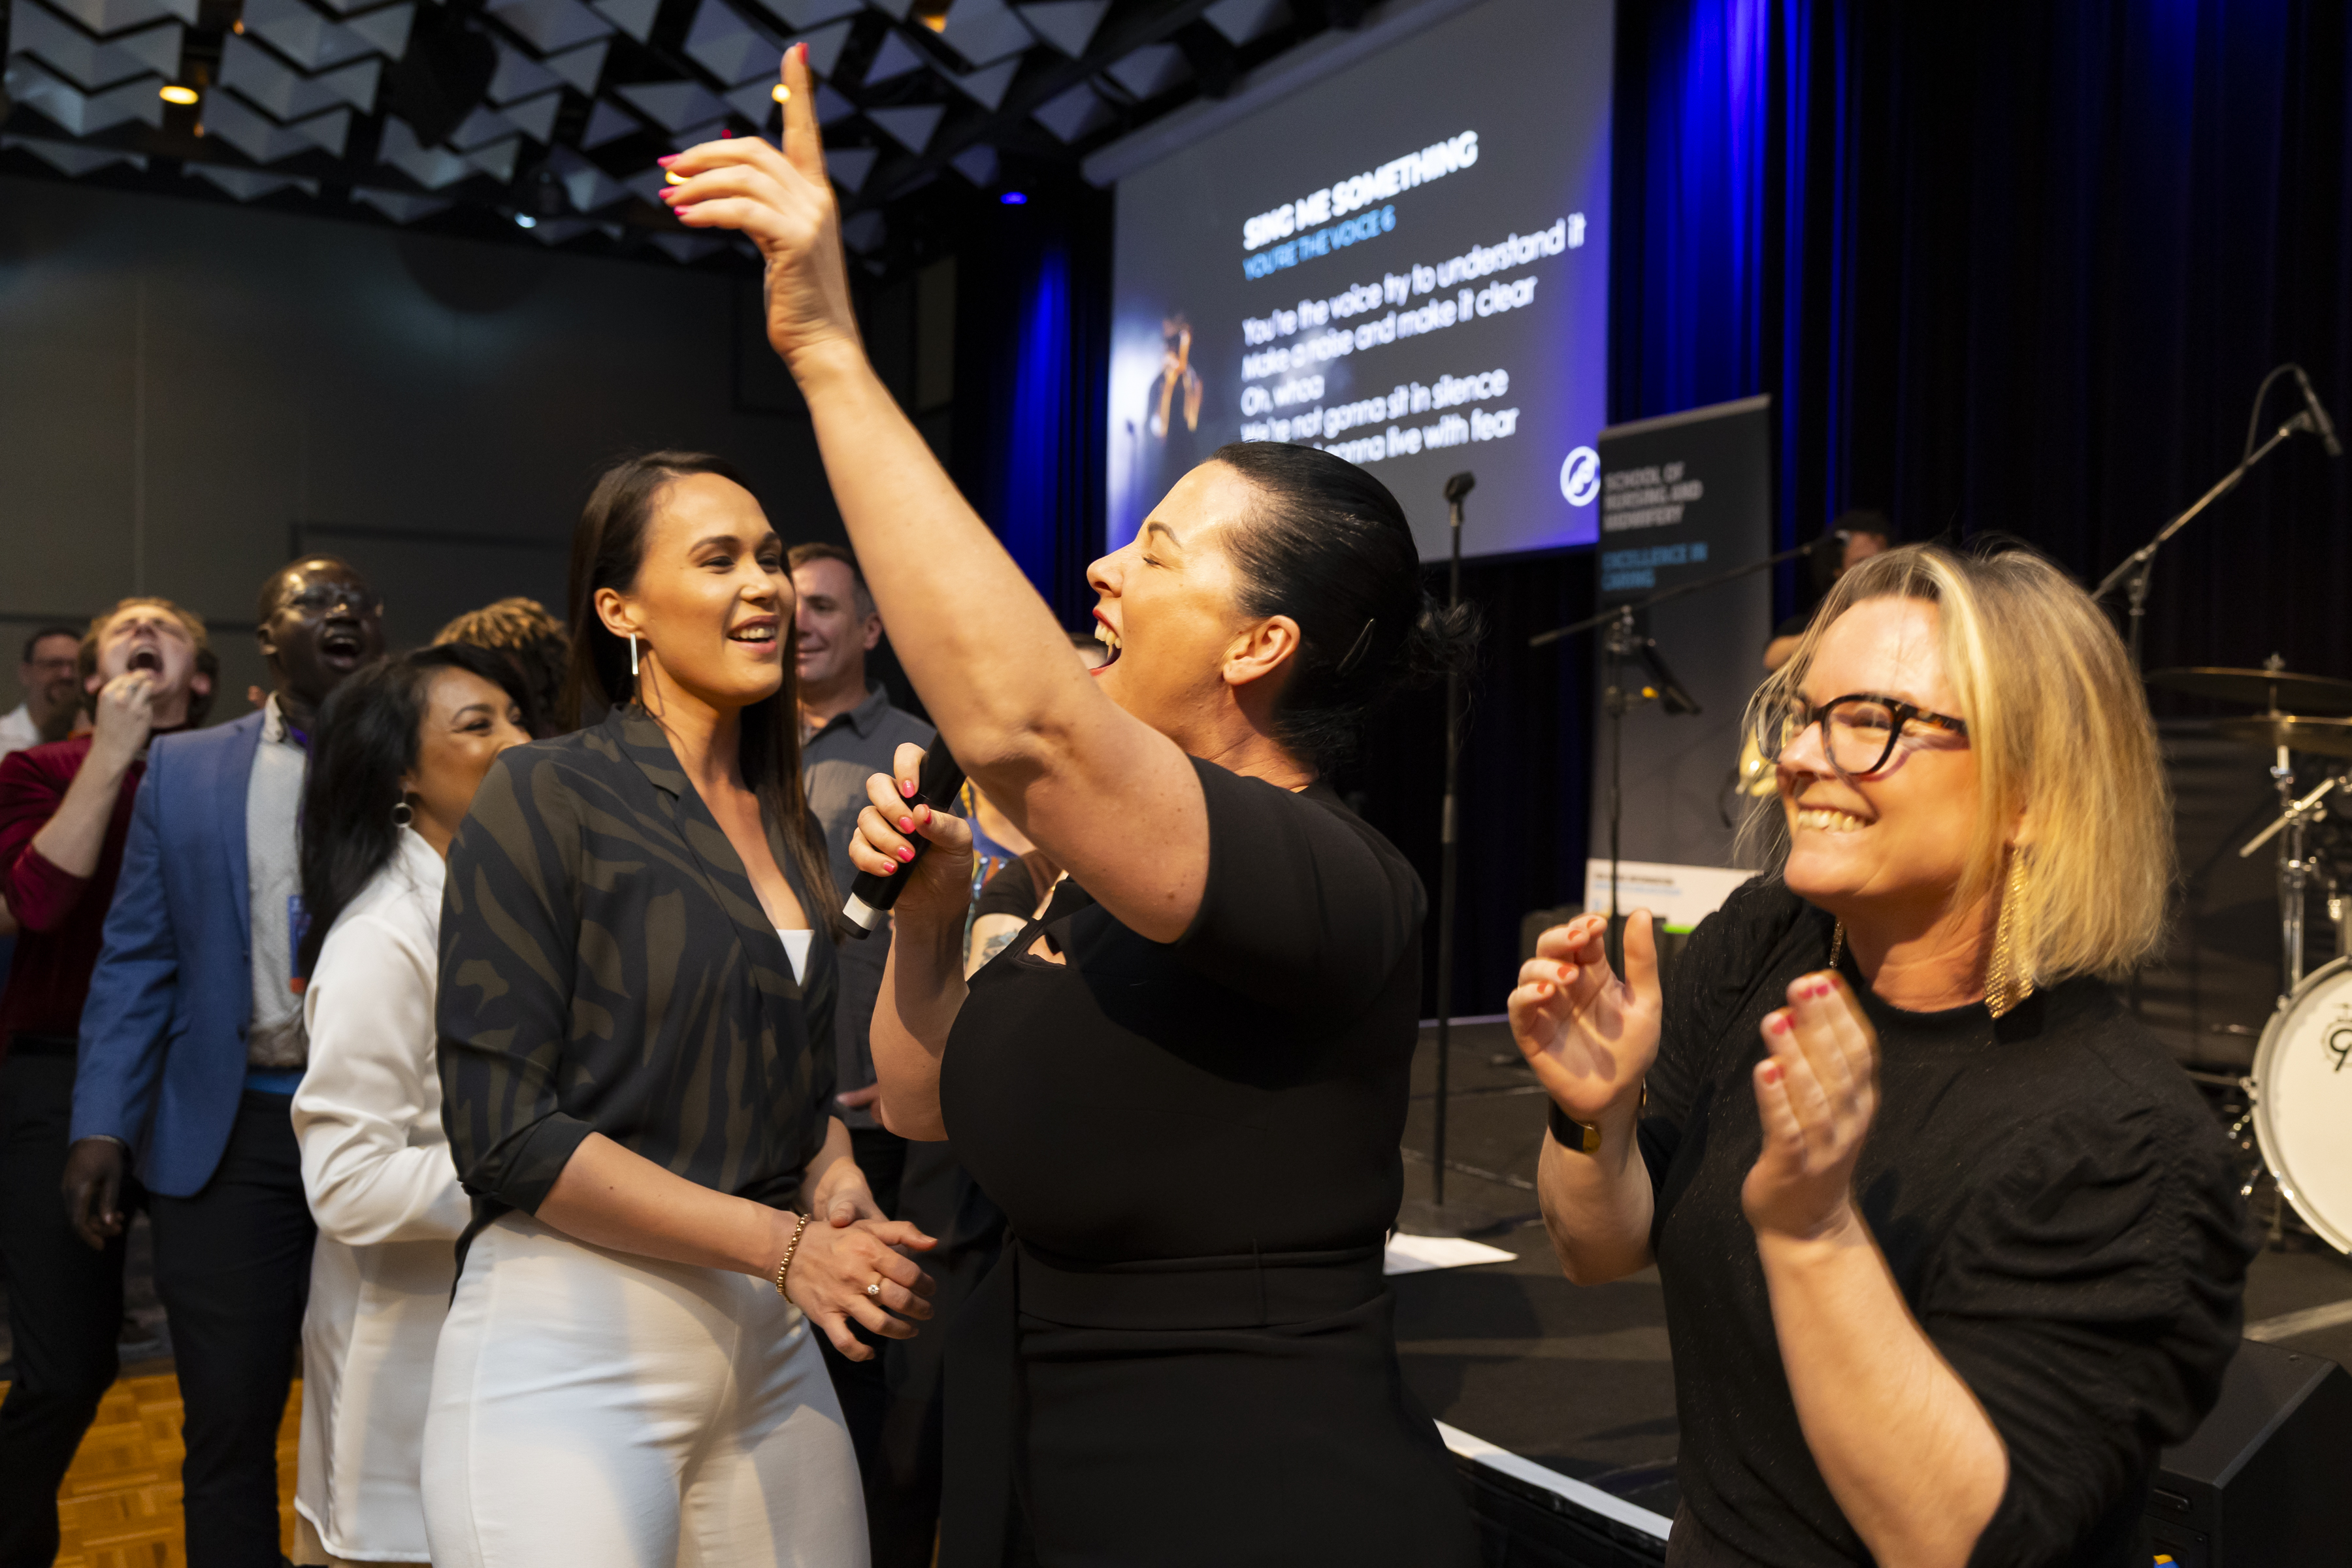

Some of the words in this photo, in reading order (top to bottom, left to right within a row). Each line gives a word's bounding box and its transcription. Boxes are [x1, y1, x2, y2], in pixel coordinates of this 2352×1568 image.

[1243, 203, 1295, 251] SING
[1295, 188, 1332, 231] ME
[1331, 130, 1479, 218] SOMETHING
[1296, 228, 1331, 262] THE
[1329, 209, 1382, 250] VOICE
[1380, 203, 1397, 233] 6
[1241, 308, 1298, 347] You're
[1297, 298, 1330, 331] the
[1328, 282, 1384, 319] voice
[1382, 271, 1412, 307] try
[1411, 262, 1437, 295] to
[1437, 217, 1567, 288] understand
[1567, 211, 1588, 250] it
[1241, 345, 1292, 383] Make
[1289, 342, 1307, 369] a
[1305, 327, 1355, 362] noise
[1354, 310, 1397, 351] and
[1396, 297, 1458, 339] make
[1458, 287, 1475, 323] it
[1475, 275, 1539, 318] clear
[1272, 374, 1325, 408] whoa
[1290, 404, 1324, 441] not
[1322, 395, 1387, 440] gonna
[1386, 384, 1409, 420] sit
[1409, 381, 1431, 414] in
[1431, 368, 1510, 410] silence
[1385, 425, 1423, 458] live
[1422, 413, 1469, 450] with
[1470, 406, 1520, 442] fear
[1604, 465, 1661, 491] SCHOOL
[1663, 460, 1686, 485] OF
